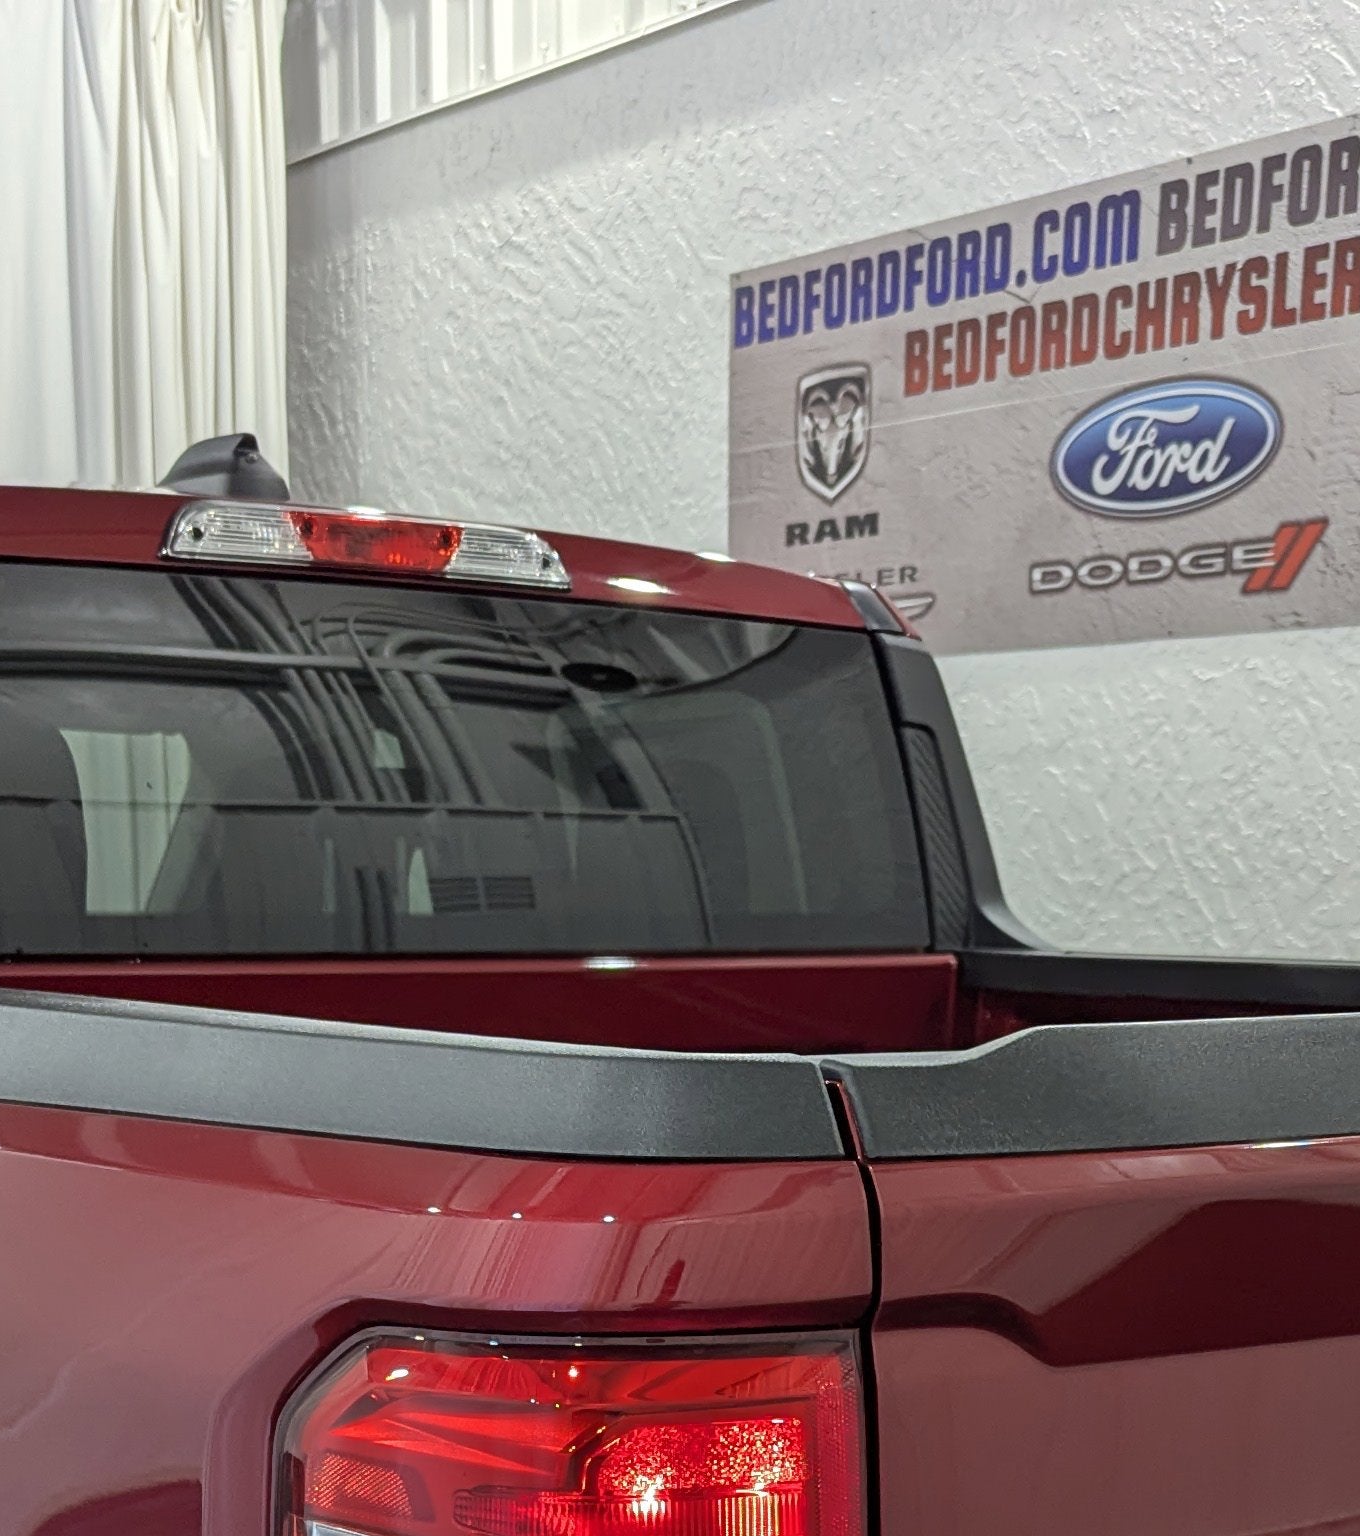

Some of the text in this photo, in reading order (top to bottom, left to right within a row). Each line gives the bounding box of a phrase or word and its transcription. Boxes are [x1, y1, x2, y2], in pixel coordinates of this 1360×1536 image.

[734, 189, 1141, 349] BEDFORDFORD.COM
[1092, 402, 1237, 494] Ford
[785, 512, 880, 547] RAM
[1028, 537, 1277, 595] DODGE
